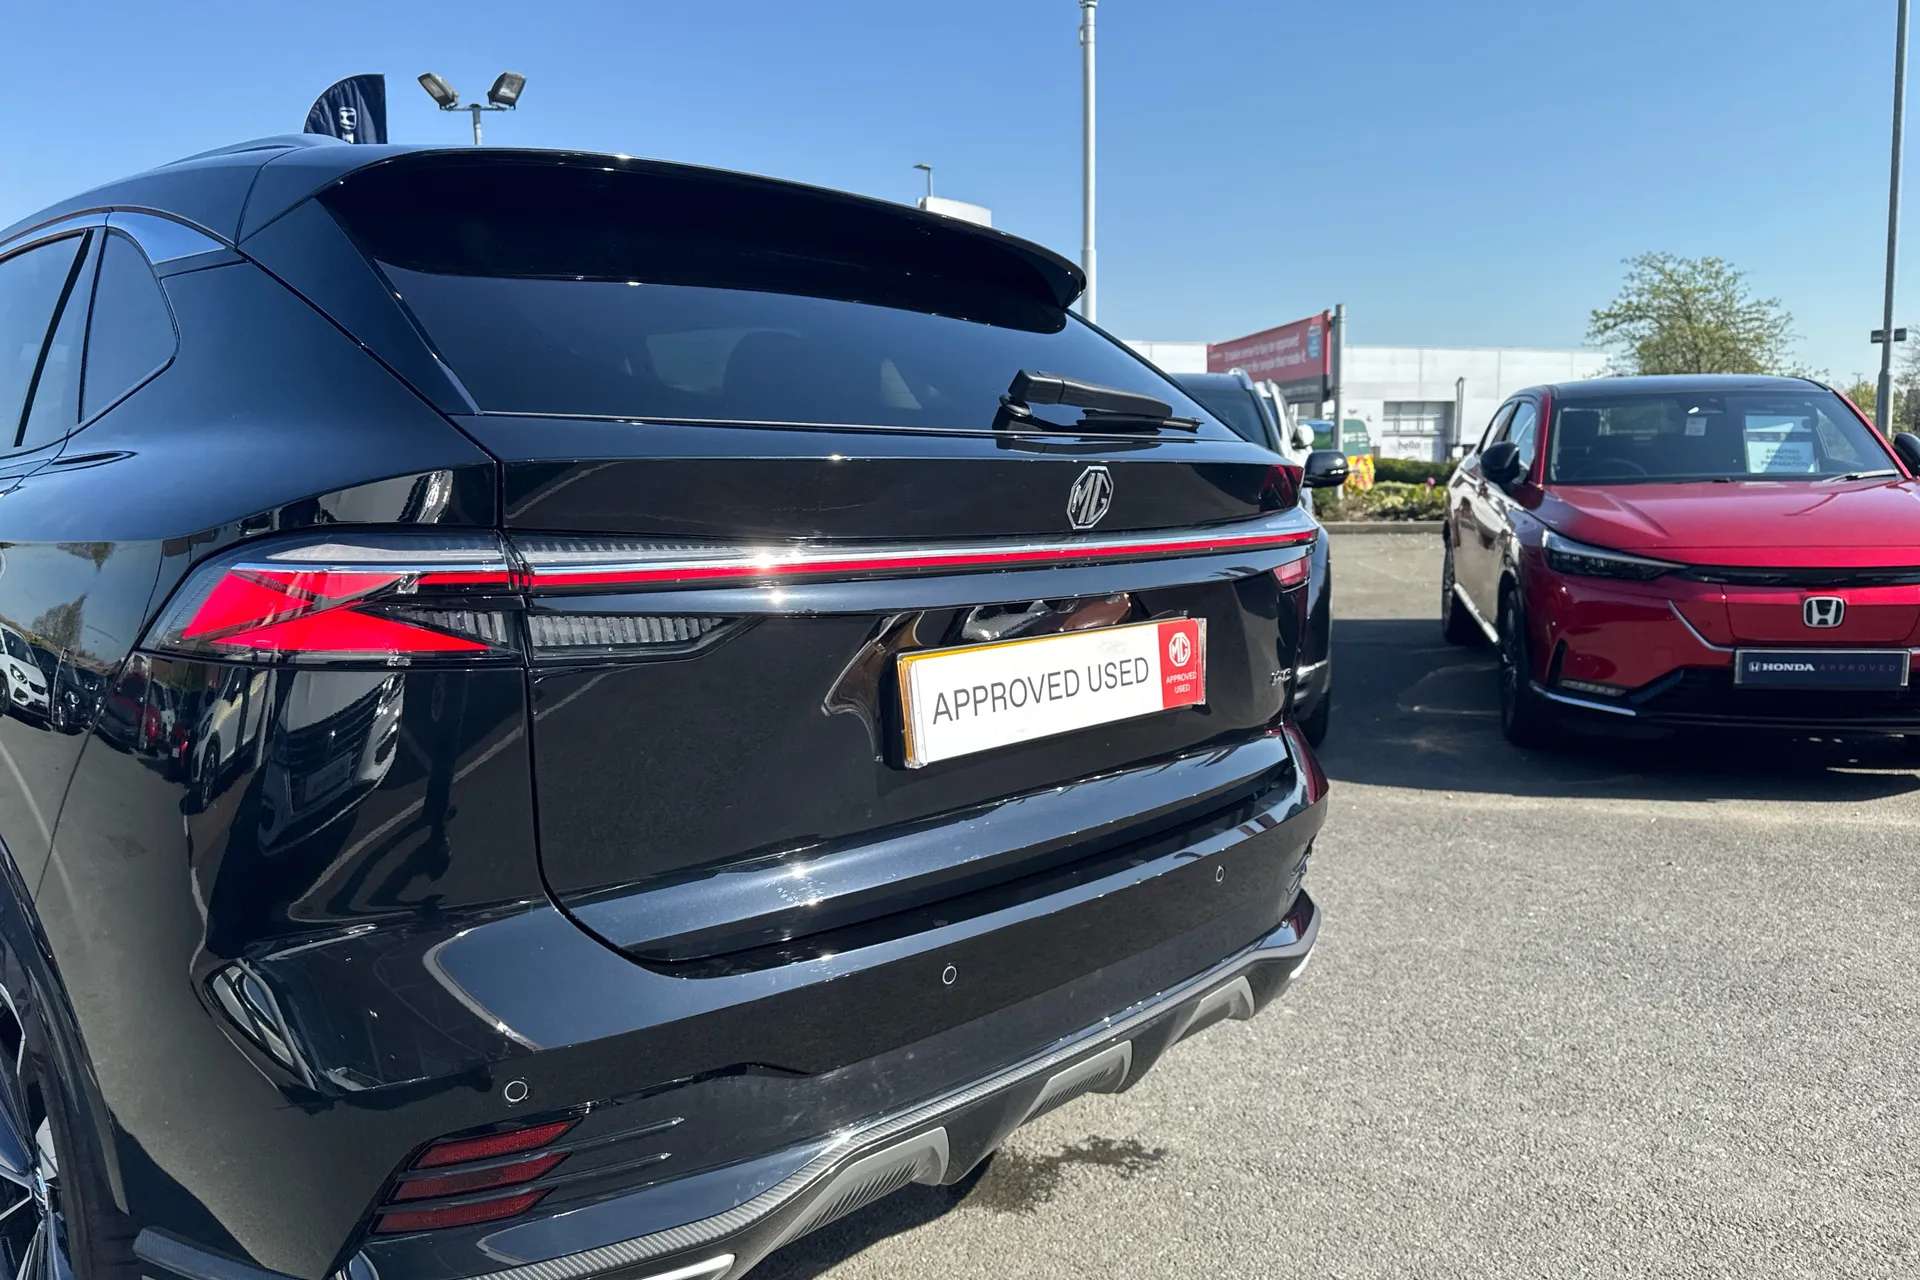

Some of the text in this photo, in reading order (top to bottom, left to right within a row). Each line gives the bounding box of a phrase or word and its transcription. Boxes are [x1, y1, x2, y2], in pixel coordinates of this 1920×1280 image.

[1068, 468, 1112, 528] MG
[1169, 633, 1191, 666] MG
[1166, 671, 1197, 684] APPROVED
[1762, 663, 1815, 672] HONDA
[1819, 664, 1897, 672] APPROVED
[933, 657, 1149, 725] APPROVED USED
[1174, 684, 1191, 695] USED
